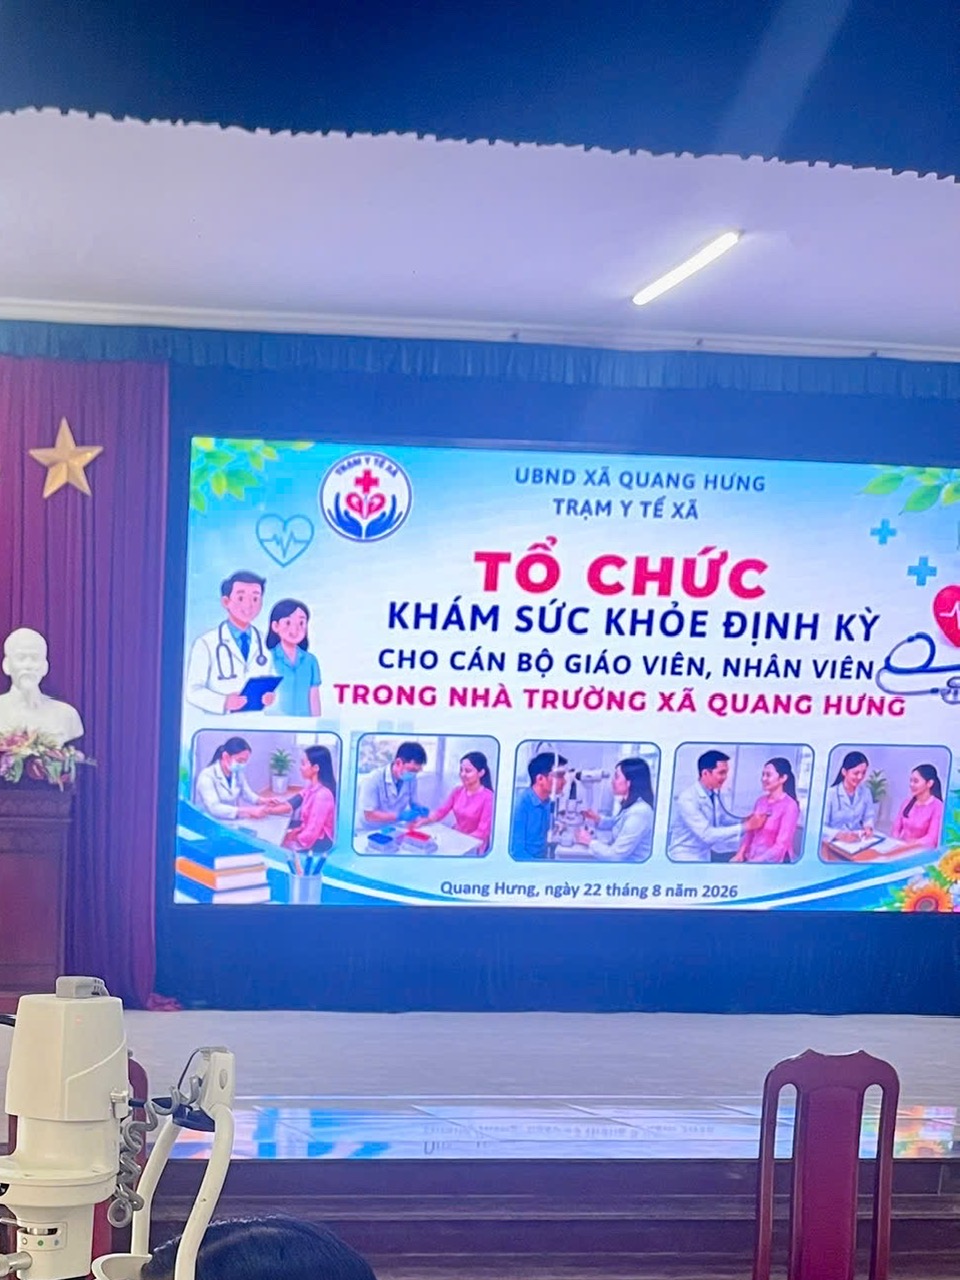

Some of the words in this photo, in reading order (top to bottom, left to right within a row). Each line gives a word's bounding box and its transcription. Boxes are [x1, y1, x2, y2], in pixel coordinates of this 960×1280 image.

[515, 466, 576, 486] UBND
[583, 465, 611, 487] XÃ
[619, 470, 696, 491] QUANG
[704, 471, 766, 492] HƯNG
[553, 497, 613, 520] TRẠM
[621, 500, 633, 518] Y
[640, 495, 665, 519] TẾ
[671, 497, 699, 520] XÃ
[474, 535, 561, 594] TỔ
[586, 545, 769, 600] CHỨC
[388, 595, 500, 633] KHÁM
[514, 598, 590, 635] SỨC
[605, 601, 709, 638] KHỎE
[722, 610, 820, 647] ĐỊNH
[835, 606, 881, 642] KỲ
[378, 648, 439, 670] CHO
[449, 645, 506, 672] CÁN
[517, 647, 554, 678] BỘ
[564, 649, 632, 675] GIÁO
[642, 651, 712, 680] VIÊN,
[722, 653, 802, 679] NHÂN
[812, 655, 875, 680] VIÊN
[333, 683, 438, 707] TRONG
[448, 683, 513, 709] NHÀ
[523, 685, 647, 711] TRƯỜNG
[657, 687, 697, 713] XÃ
[707, 692, 813, 717] QUANG
[823, 692, 906, 717] HƯNG
[440, 880, 490, 898] Quang
[494, 881, 540, 898] Hưng,
[545, 881, 580, 899] ngày
[583, 882, 602, 897] 22
[606, 882, 648, 900] tháng
[652, 883, 662, 898] 8
[665, 883, 698, 898] năm
[701, 884, 738, 899] 2026
